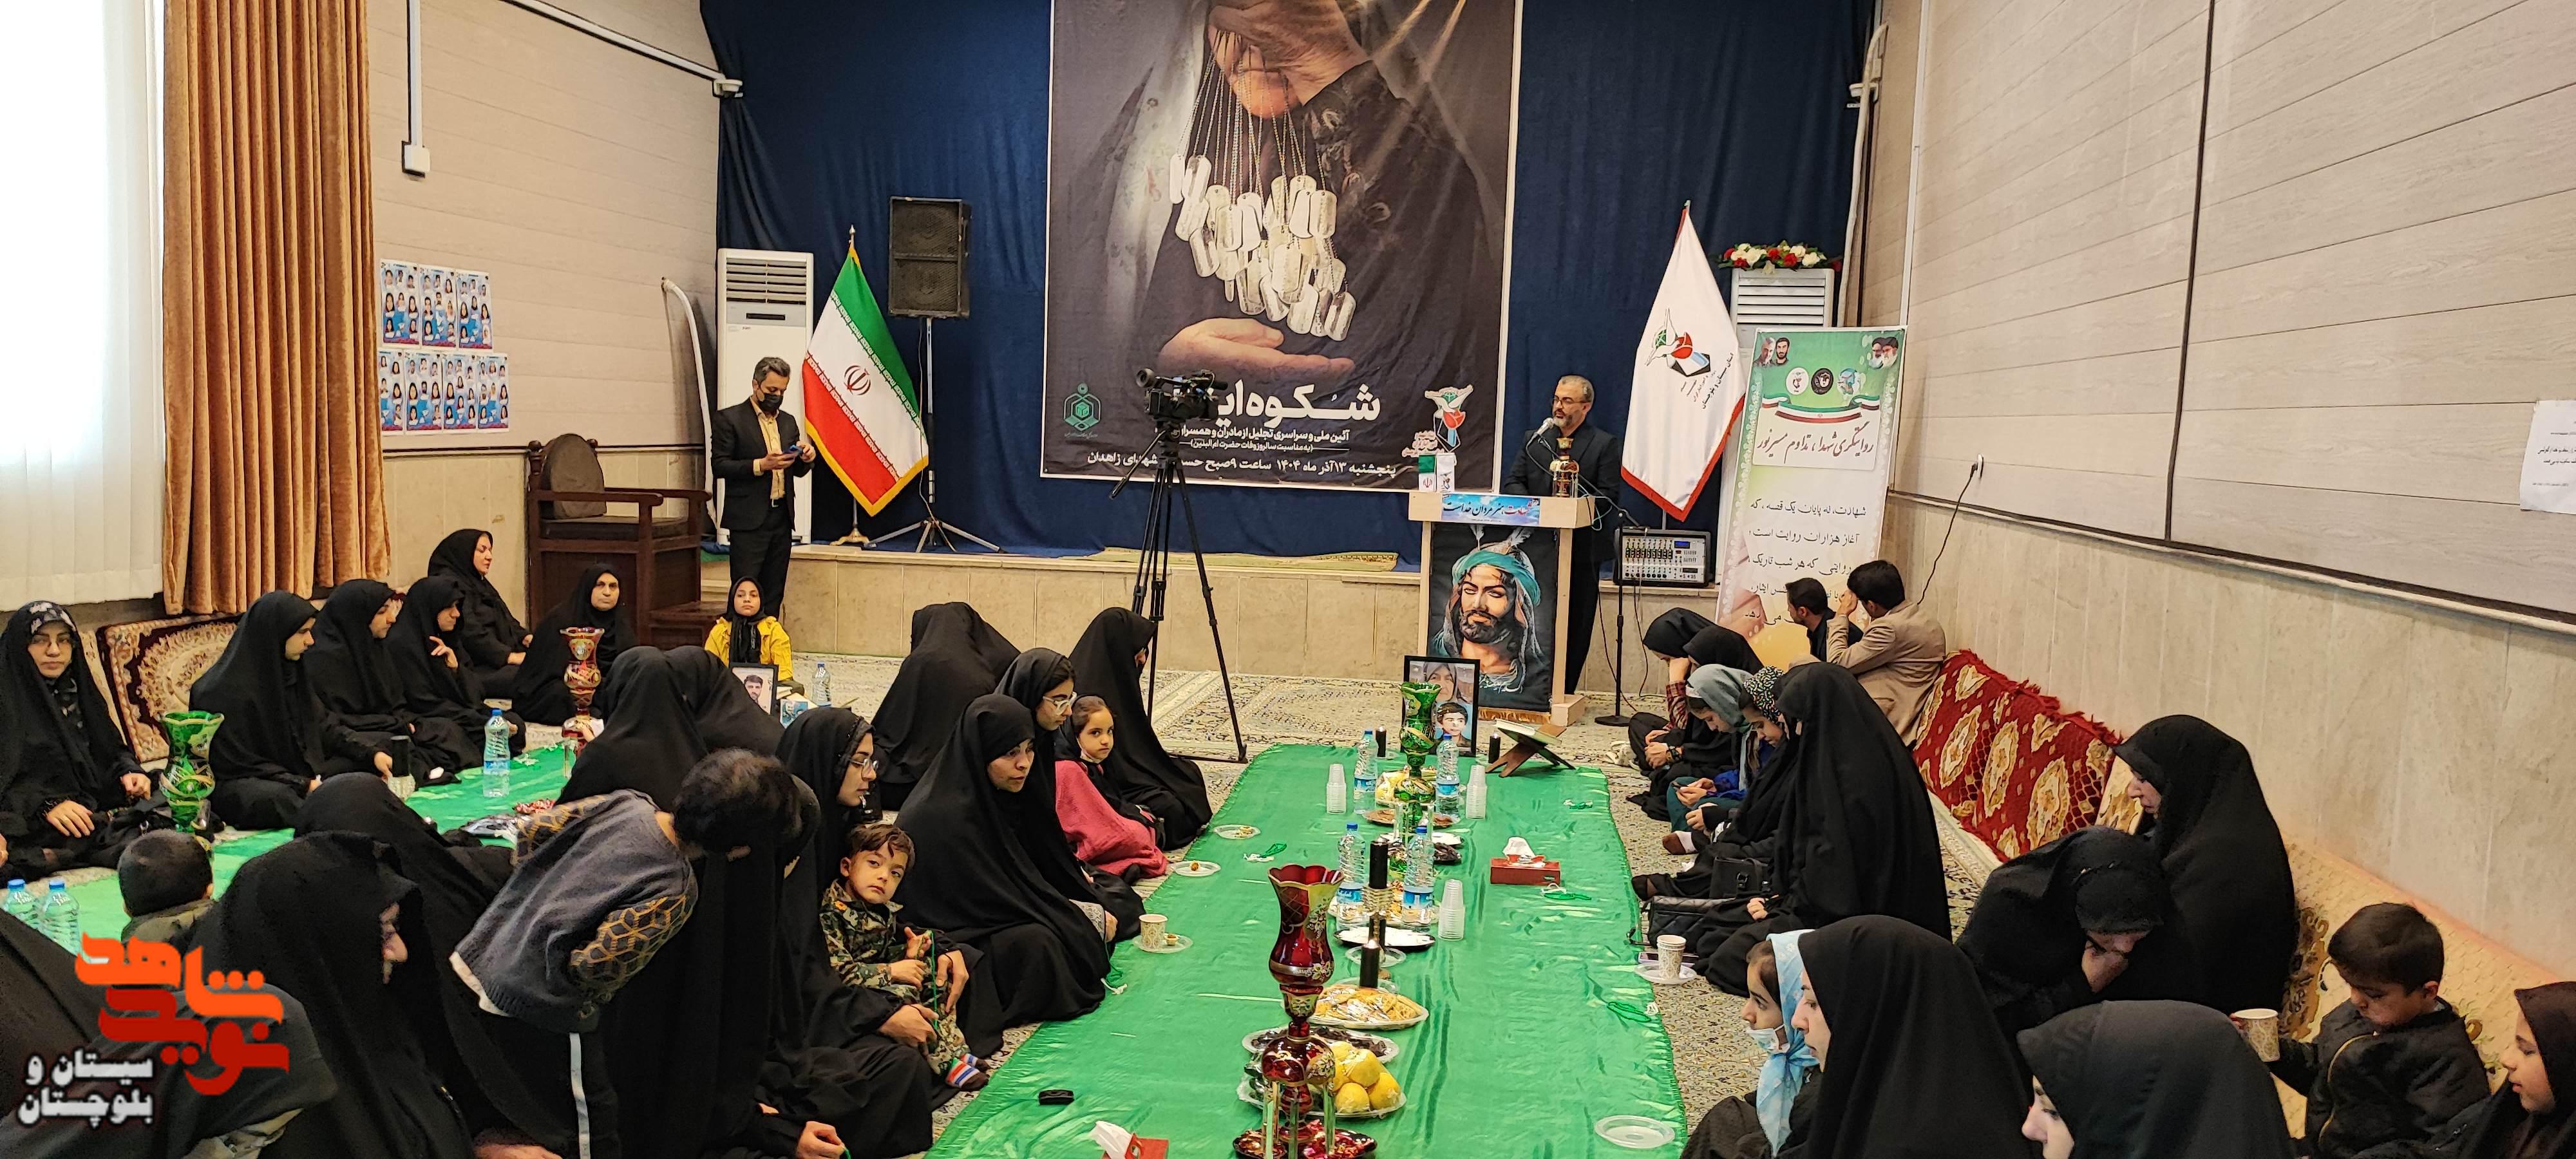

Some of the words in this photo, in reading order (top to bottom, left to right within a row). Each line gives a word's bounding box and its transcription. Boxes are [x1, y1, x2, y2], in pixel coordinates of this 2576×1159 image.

[1181, 424, 1211, 437] همسرا
[1211, 429, 1217, 438] و
[1217, 426, 1241, 438] مادران
[1241, 427, 1248, 440] از
[1248, 427, 1274, 440] تجلیل
[1274, 429, 1308, 442] سراسری
[1314, 430, 1331, 442] ملی
[1308, 433, 1314, 442] و
[1756, 428, 1774, 449] نور
[1211, 439, 1219, 449] ام
[1219, 440, 1241, 449] حضرت
[1241, 440, 1256, 451] وفات
[1256, 440, 1276, 451] سالروز
[1276, 442, 1305, 451] مناسبت
[1783, 433, 1812, 464] تداوم
[1087, 451, 1121, 466] زاهدان
[1238, 458, 1272, 471] ساعت
[1302, 460, 1317, 471] ماه
[1349, 462, 1396, 479] پنجشنبه
[1491, 503, 1504, 516] هنر
[1750, 498, 1762, 509] که
[1785, 500, 1797, 514] یک
[1472, 504, 1492, 516] مردان
[1797, 504, 1822, 517] پایان
[1775, 530, 1802, 543] روایت
[1803, 531, 1840, 546] هزاران
[1842, 533, 1860, 547] آغاز
[1774, 557, 1793, 569] شب
[1794, 560, 1805, 570] هر
[1806, 558, 1819, 569] که
[1763, 614, 1782, 625] می
